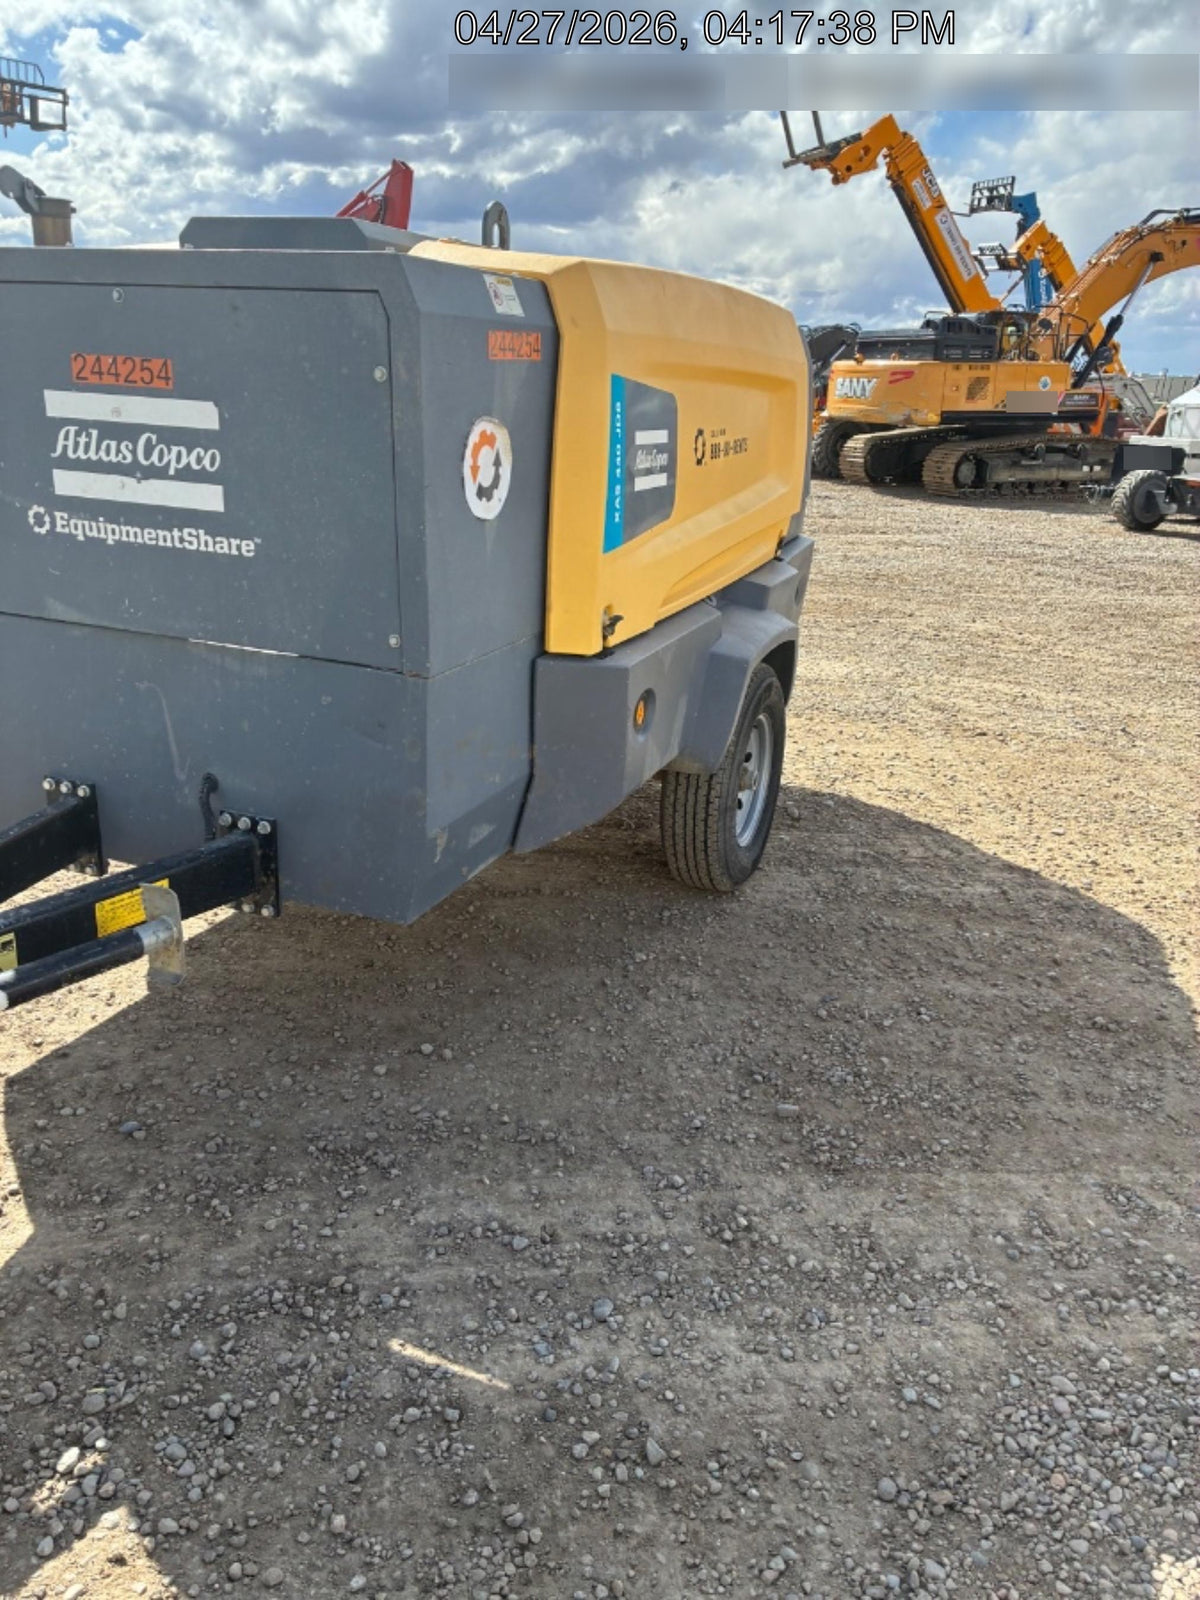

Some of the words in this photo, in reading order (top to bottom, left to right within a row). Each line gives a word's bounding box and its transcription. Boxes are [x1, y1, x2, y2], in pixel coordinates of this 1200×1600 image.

[922, 166, 941, 198] JCB
[73, 353, 172, 386] 244254
[835, 377, 880, 400] SANY
[51, 425, 133, 464] Atlas
[137, 432, 221, 475] Copco
[54, 511, 256, 557] EquipmentShare
